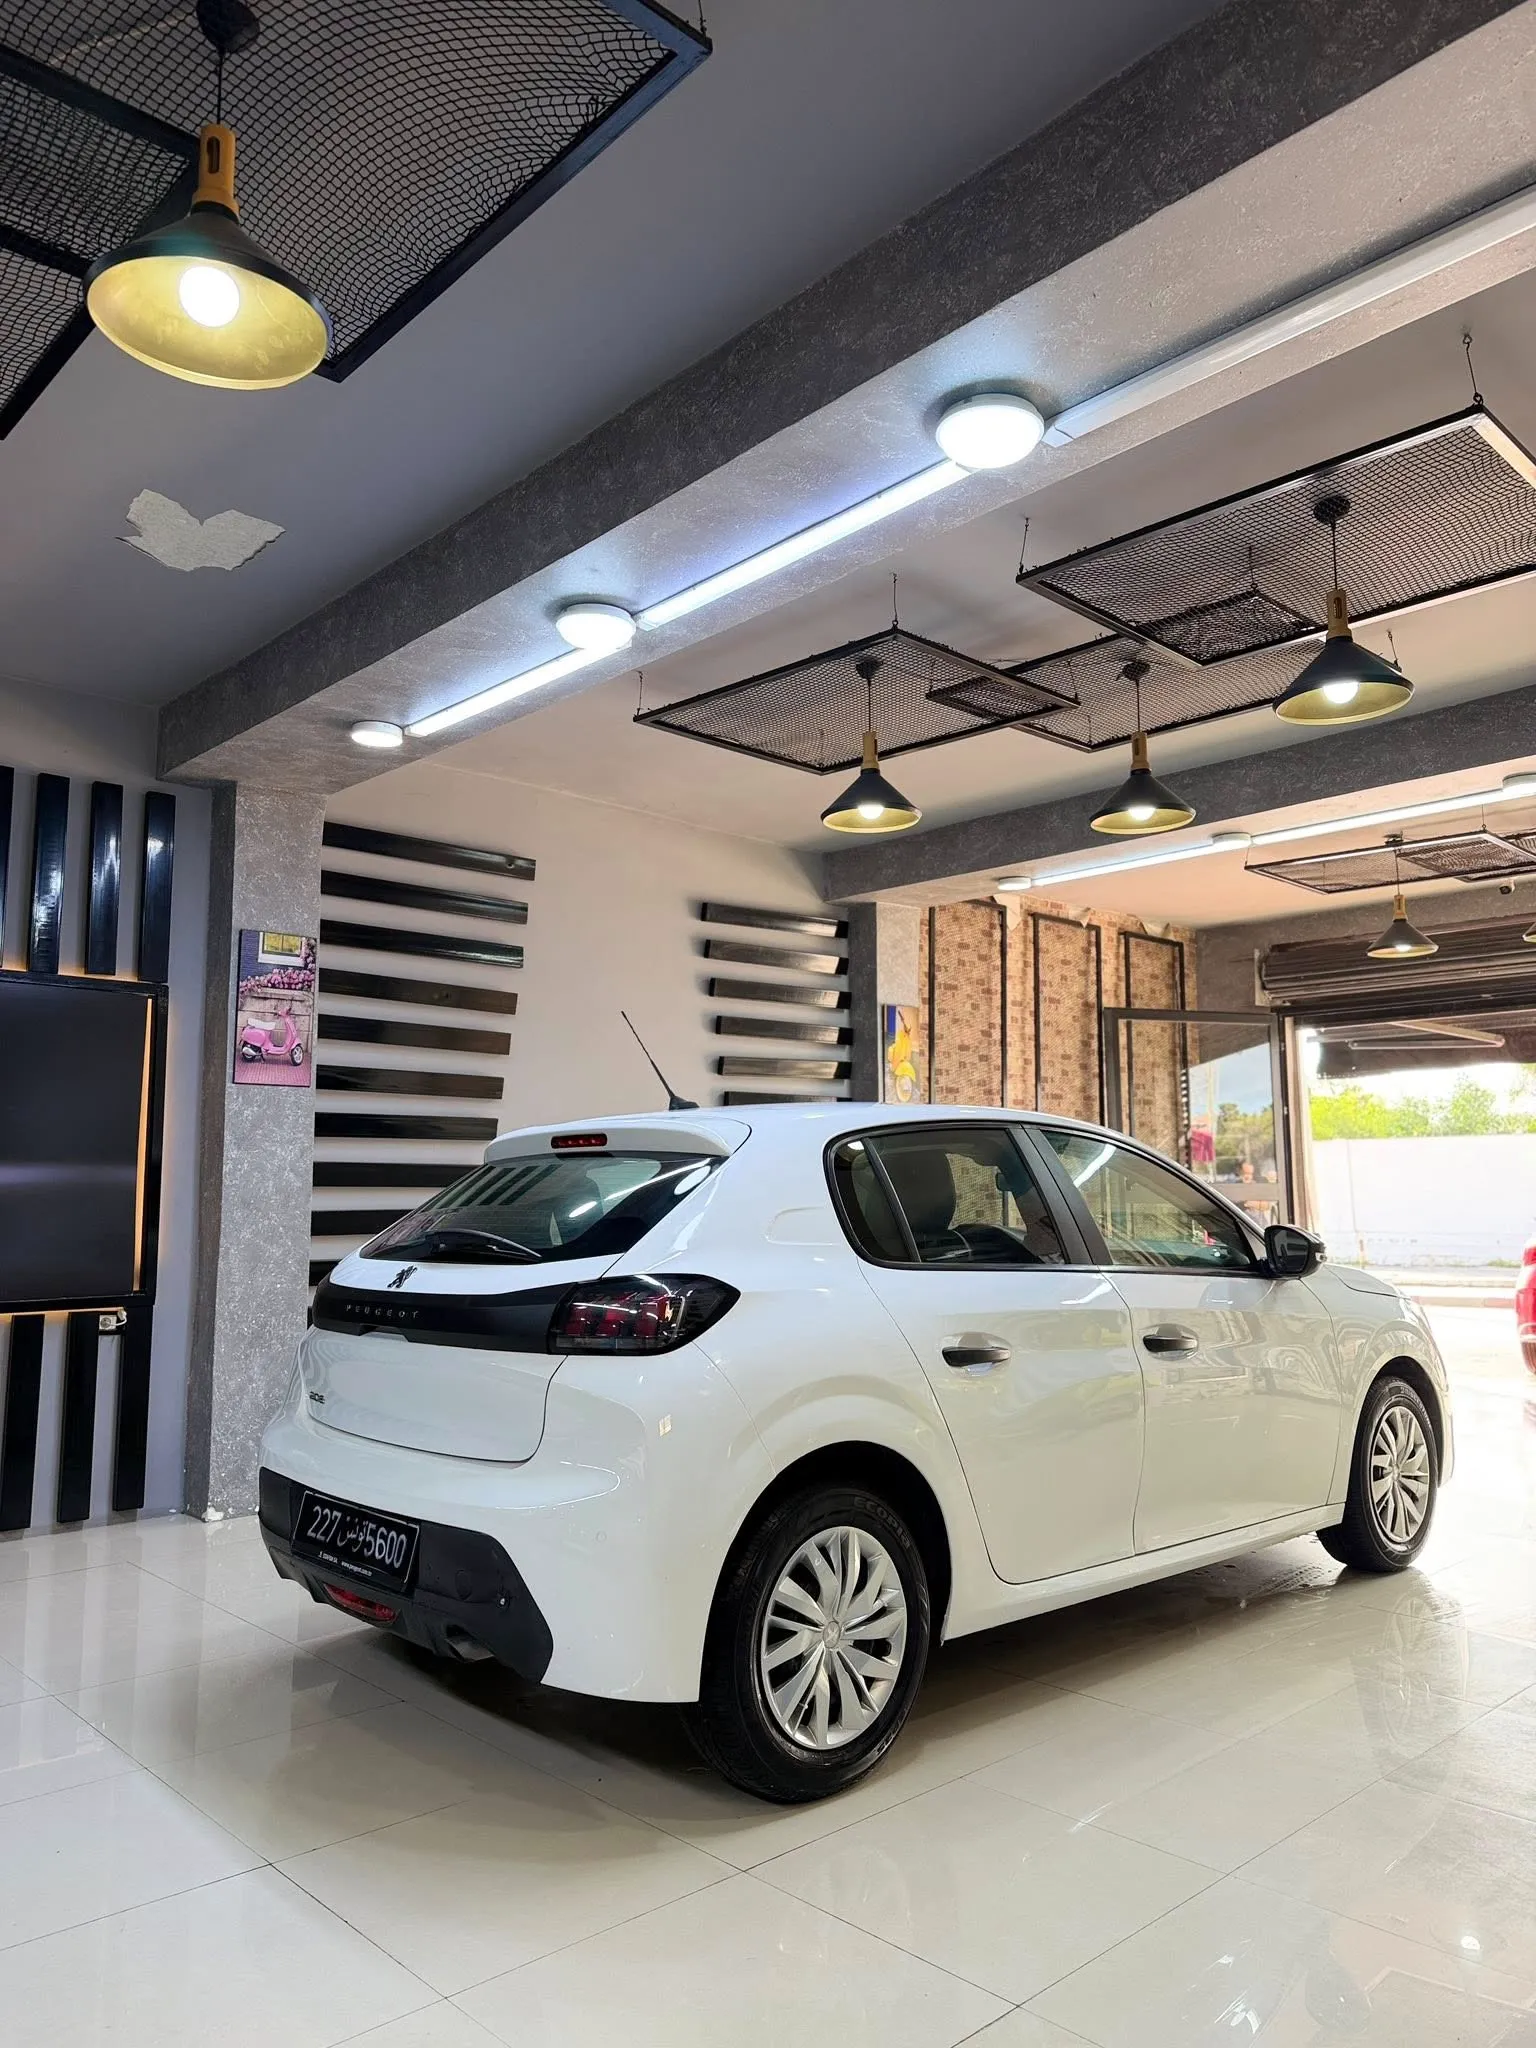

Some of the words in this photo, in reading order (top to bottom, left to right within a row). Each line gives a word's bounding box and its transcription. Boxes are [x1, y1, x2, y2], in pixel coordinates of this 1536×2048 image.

[346, 1304, 419, 1319] PEUGEOT
[307, 1505, 342, 1543] 227
[363, 1522, 407, 1568] 5600
